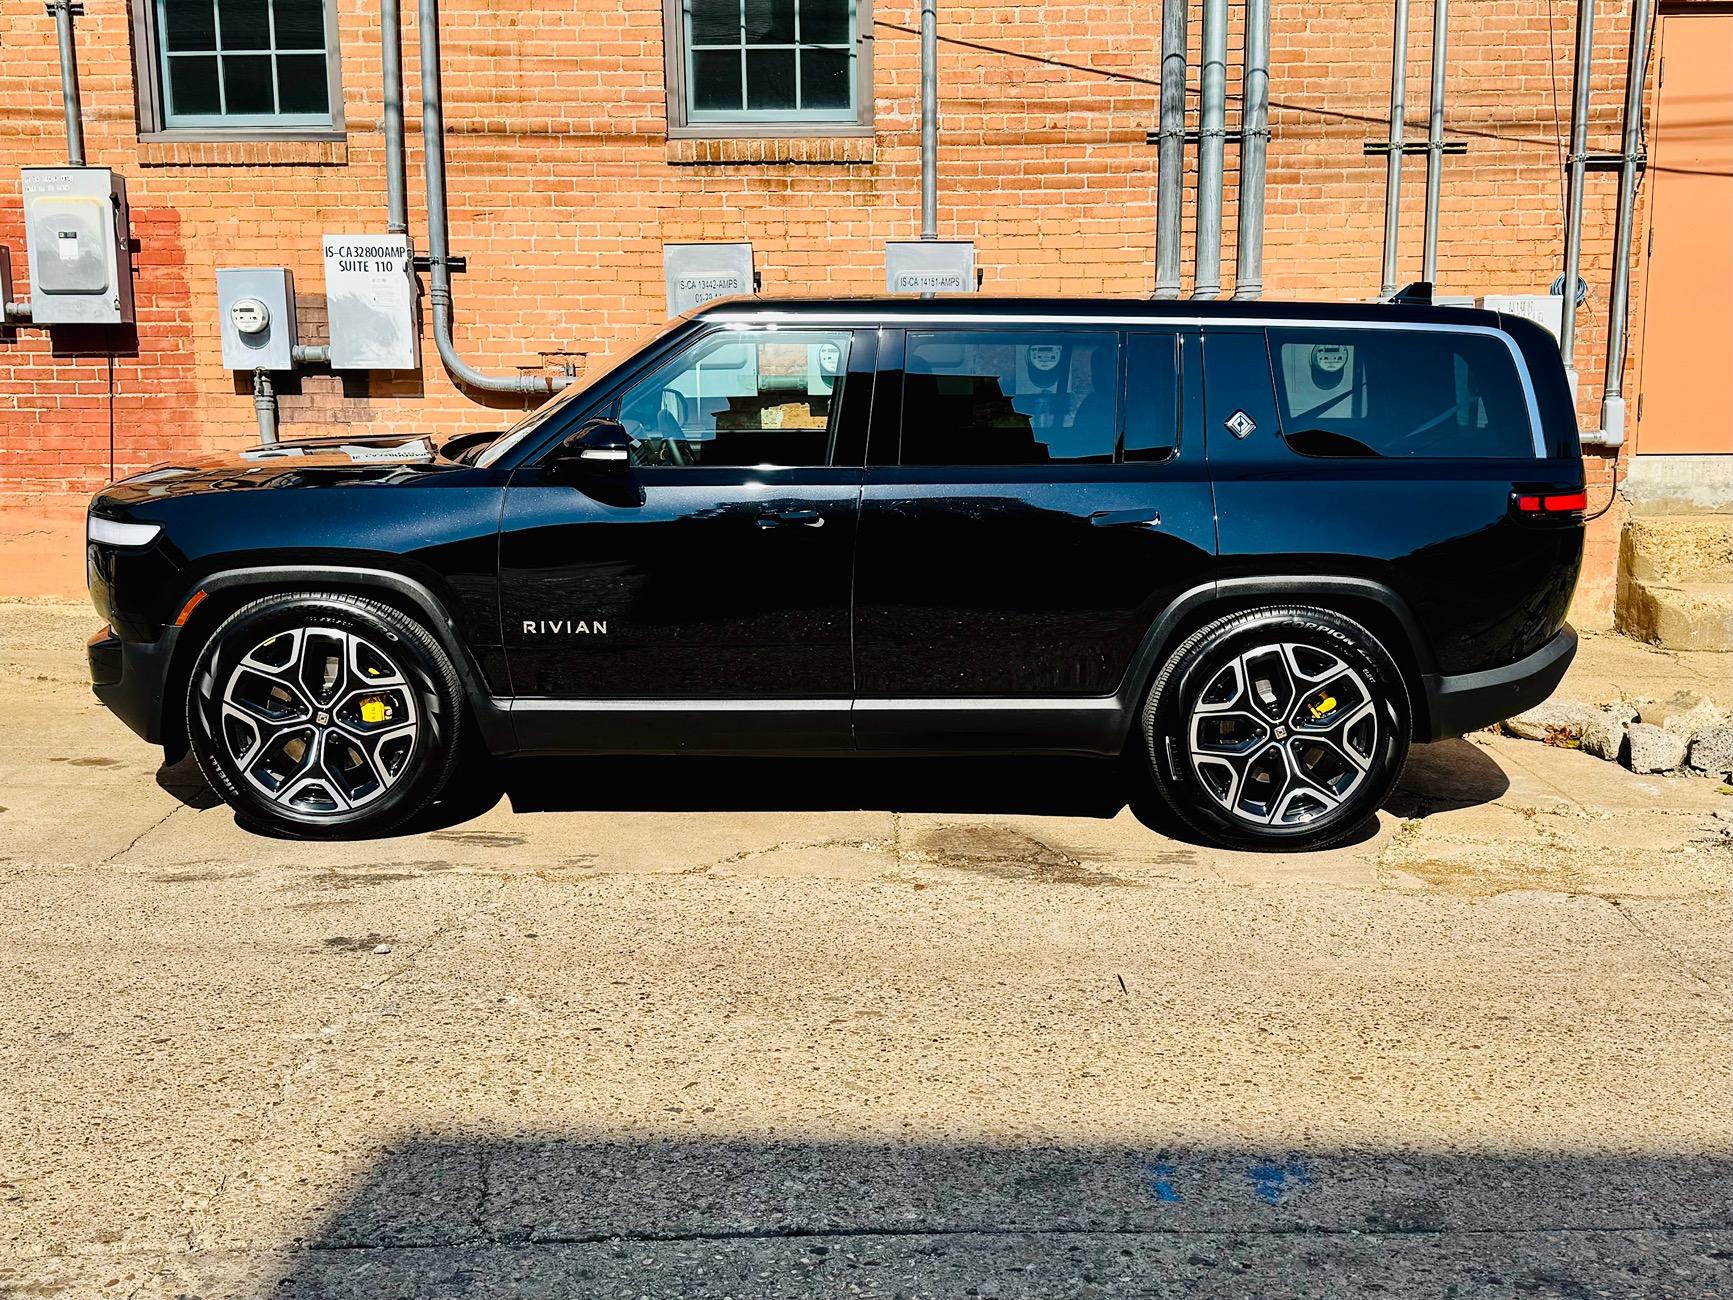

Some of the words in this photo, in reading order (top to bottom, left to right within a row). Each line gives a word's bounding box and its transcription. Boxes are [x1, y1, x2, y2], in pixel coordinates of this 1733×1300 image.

[338, 260, 369, 272] SUITE
[374, 261, 393, 272] 110
[522, 620, 607, 634] RIVIAN
